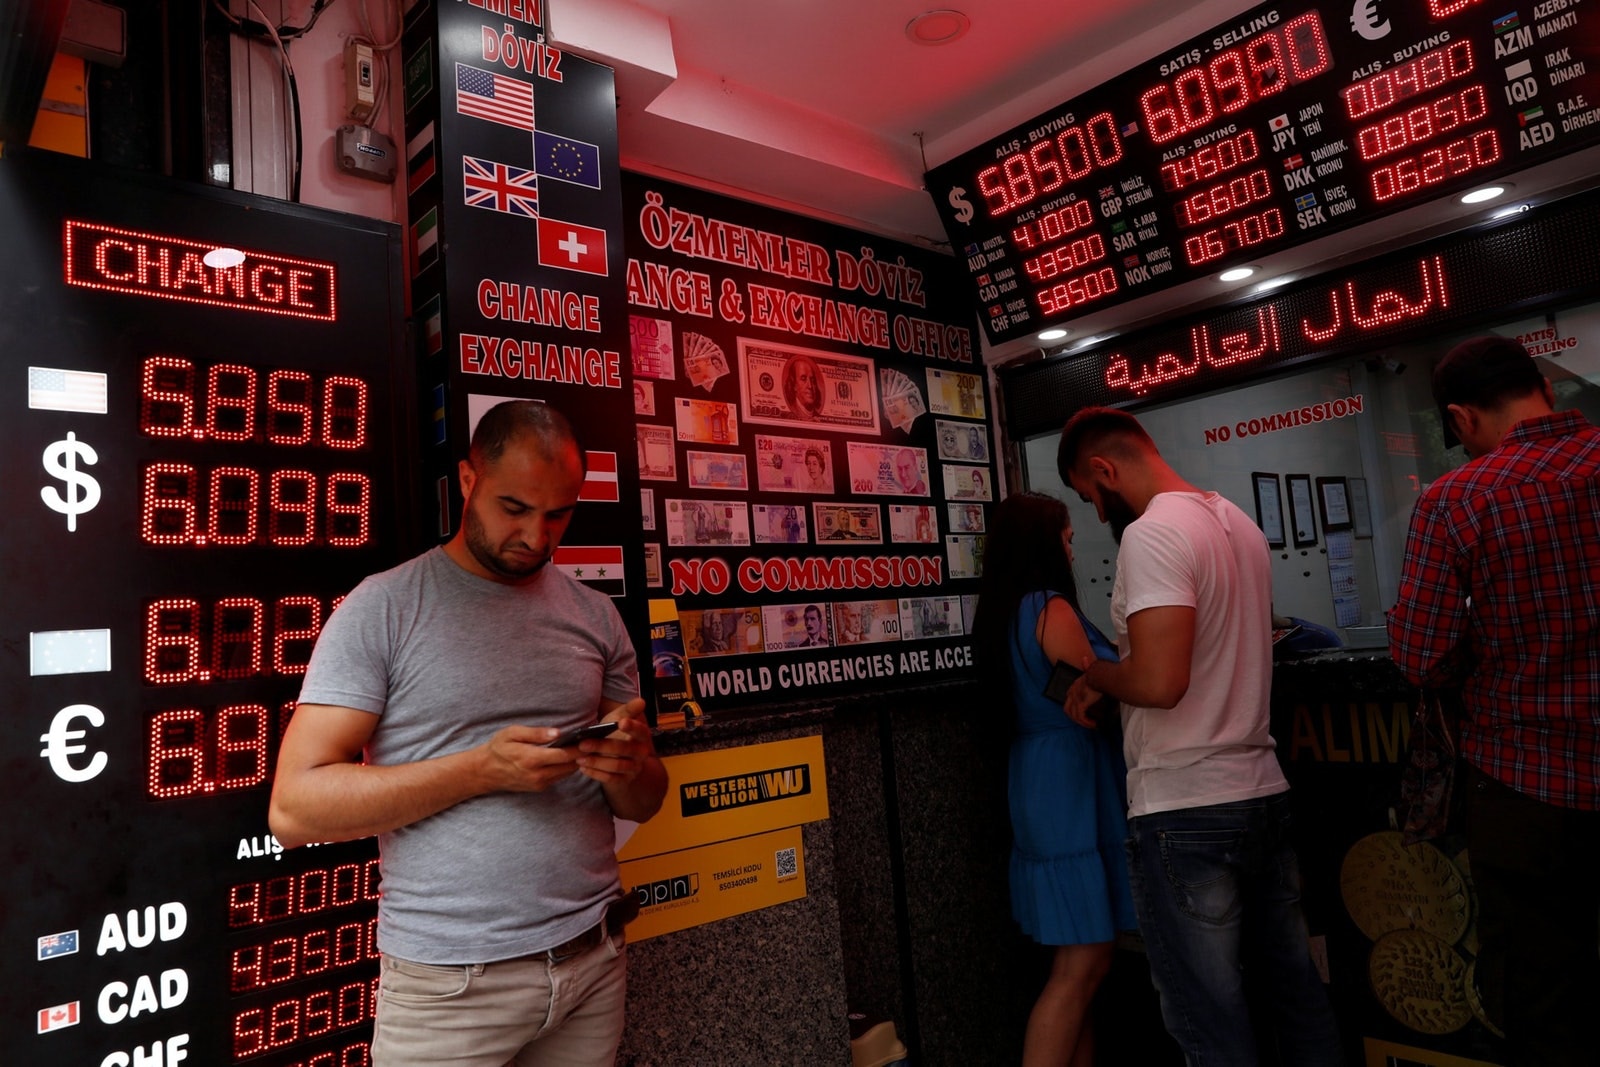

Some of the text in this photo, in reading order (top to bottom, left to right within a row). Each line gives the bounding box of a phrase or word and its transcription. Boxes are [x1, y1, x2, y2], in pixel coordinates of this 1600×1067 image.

[1533, 0, 1581, 21] AZERB
[1537, 10, 1578, 39] MANATI
[482, 23, 563, 83] DÖVİZ
[1159, 10, 1280, 78] SATIŞ SELLING
[1351, 30, 1451, 82] ALIŞ BUYING
[1494, 24, 1534, 60] AZM
[1544, 47, 1571, 69] IRAK
[1141, 14, 1329, 143] 6.0990
[1549, 61, 1586, 87] DİNARI
[1504, 76, 1539, 106] IQD
[1557, 94, 1588, 116] B.A.E.
[1298, 102, 1324, 123] JAPON
[995, 113, 1076, 159] ALIŞ BUYING
[1162, 123, 1237, 162] ALIŞ BUYING
[1272, 127, 1297, 153] JPY
[1302, 118, 1322, 139] YENİ
[1519, 121, 1556, 152] AED
[977, 111, 1123, 216] 5.8500
[1161, 130, 1259, 188] 7.4500
[1315, 158, 1343, 177] KRONU
[1283, 166, 1316, 192] DKK
[1323, 184, 1348, 204] İSVEÇ
[1016, 192, 1077, 224] ALIŞ BUYING
[1100, 196, 1123, 218] GBP
[1141, 211, 1158, 226] ARAB
[1296, 206, 1328, 230] SEK
[1329, 197, 1356, 217] KRONU
[1013, 200, 1094, 248] 4.1000
[640, 190, 926, 308] ÖZMENLER DÖVİZ
[1025, 233, 1106, 280] 4.3500
[1112, 231, 1137, 252] SAR
[1145, 246, 1171, 263] NORVEÇ
[95, 238, 315, 309] CHANGE
[967, 253, 988, 273] AUD
[1124, 264, 1152, 287] NOK
[1150, 260, 1173, 276] KRONU
[477, 278, 601, 333] CHANGE
[979, 284, 999, 303] CAD
[627, 258, 973, 363] ANGE & EXCHANGE OFFICE
[991, 315, 1009, 333] CHF
[1104, 255, 1448, 395] المال العالمية
[459, 333, 622, 389] EXCHANGE
[1528, 337, 1578, 357] ELLING
[143, 356, 367, 449] 5.850
[1204, 394, 1364, 446] NO COMMISSION
[142, 463, 370, 546] 6.099
[669, 556, 942, 596] NO COMMISSION
[146, 595, 346, 684] 6.72
[882, 620, 898, 634] 100
[696, 646, 973, 698] WORLD CURRENCIES ARE ACCE
[1289, 701, 1414, 764] ALIM
[149, 701, 299, 798] 6.9
[684, 775, 758, 800] WESTERN
[765, 767, 803, 797] WU
[709, 788, 760, 809] UNION
[236, 834, 285, 861] ALIŞ
[712, 863, 763, 881] TEMSİLCİ KODU
[96, 901, 187, 956] AUD
[97, 967, 189, 1024] CAD
